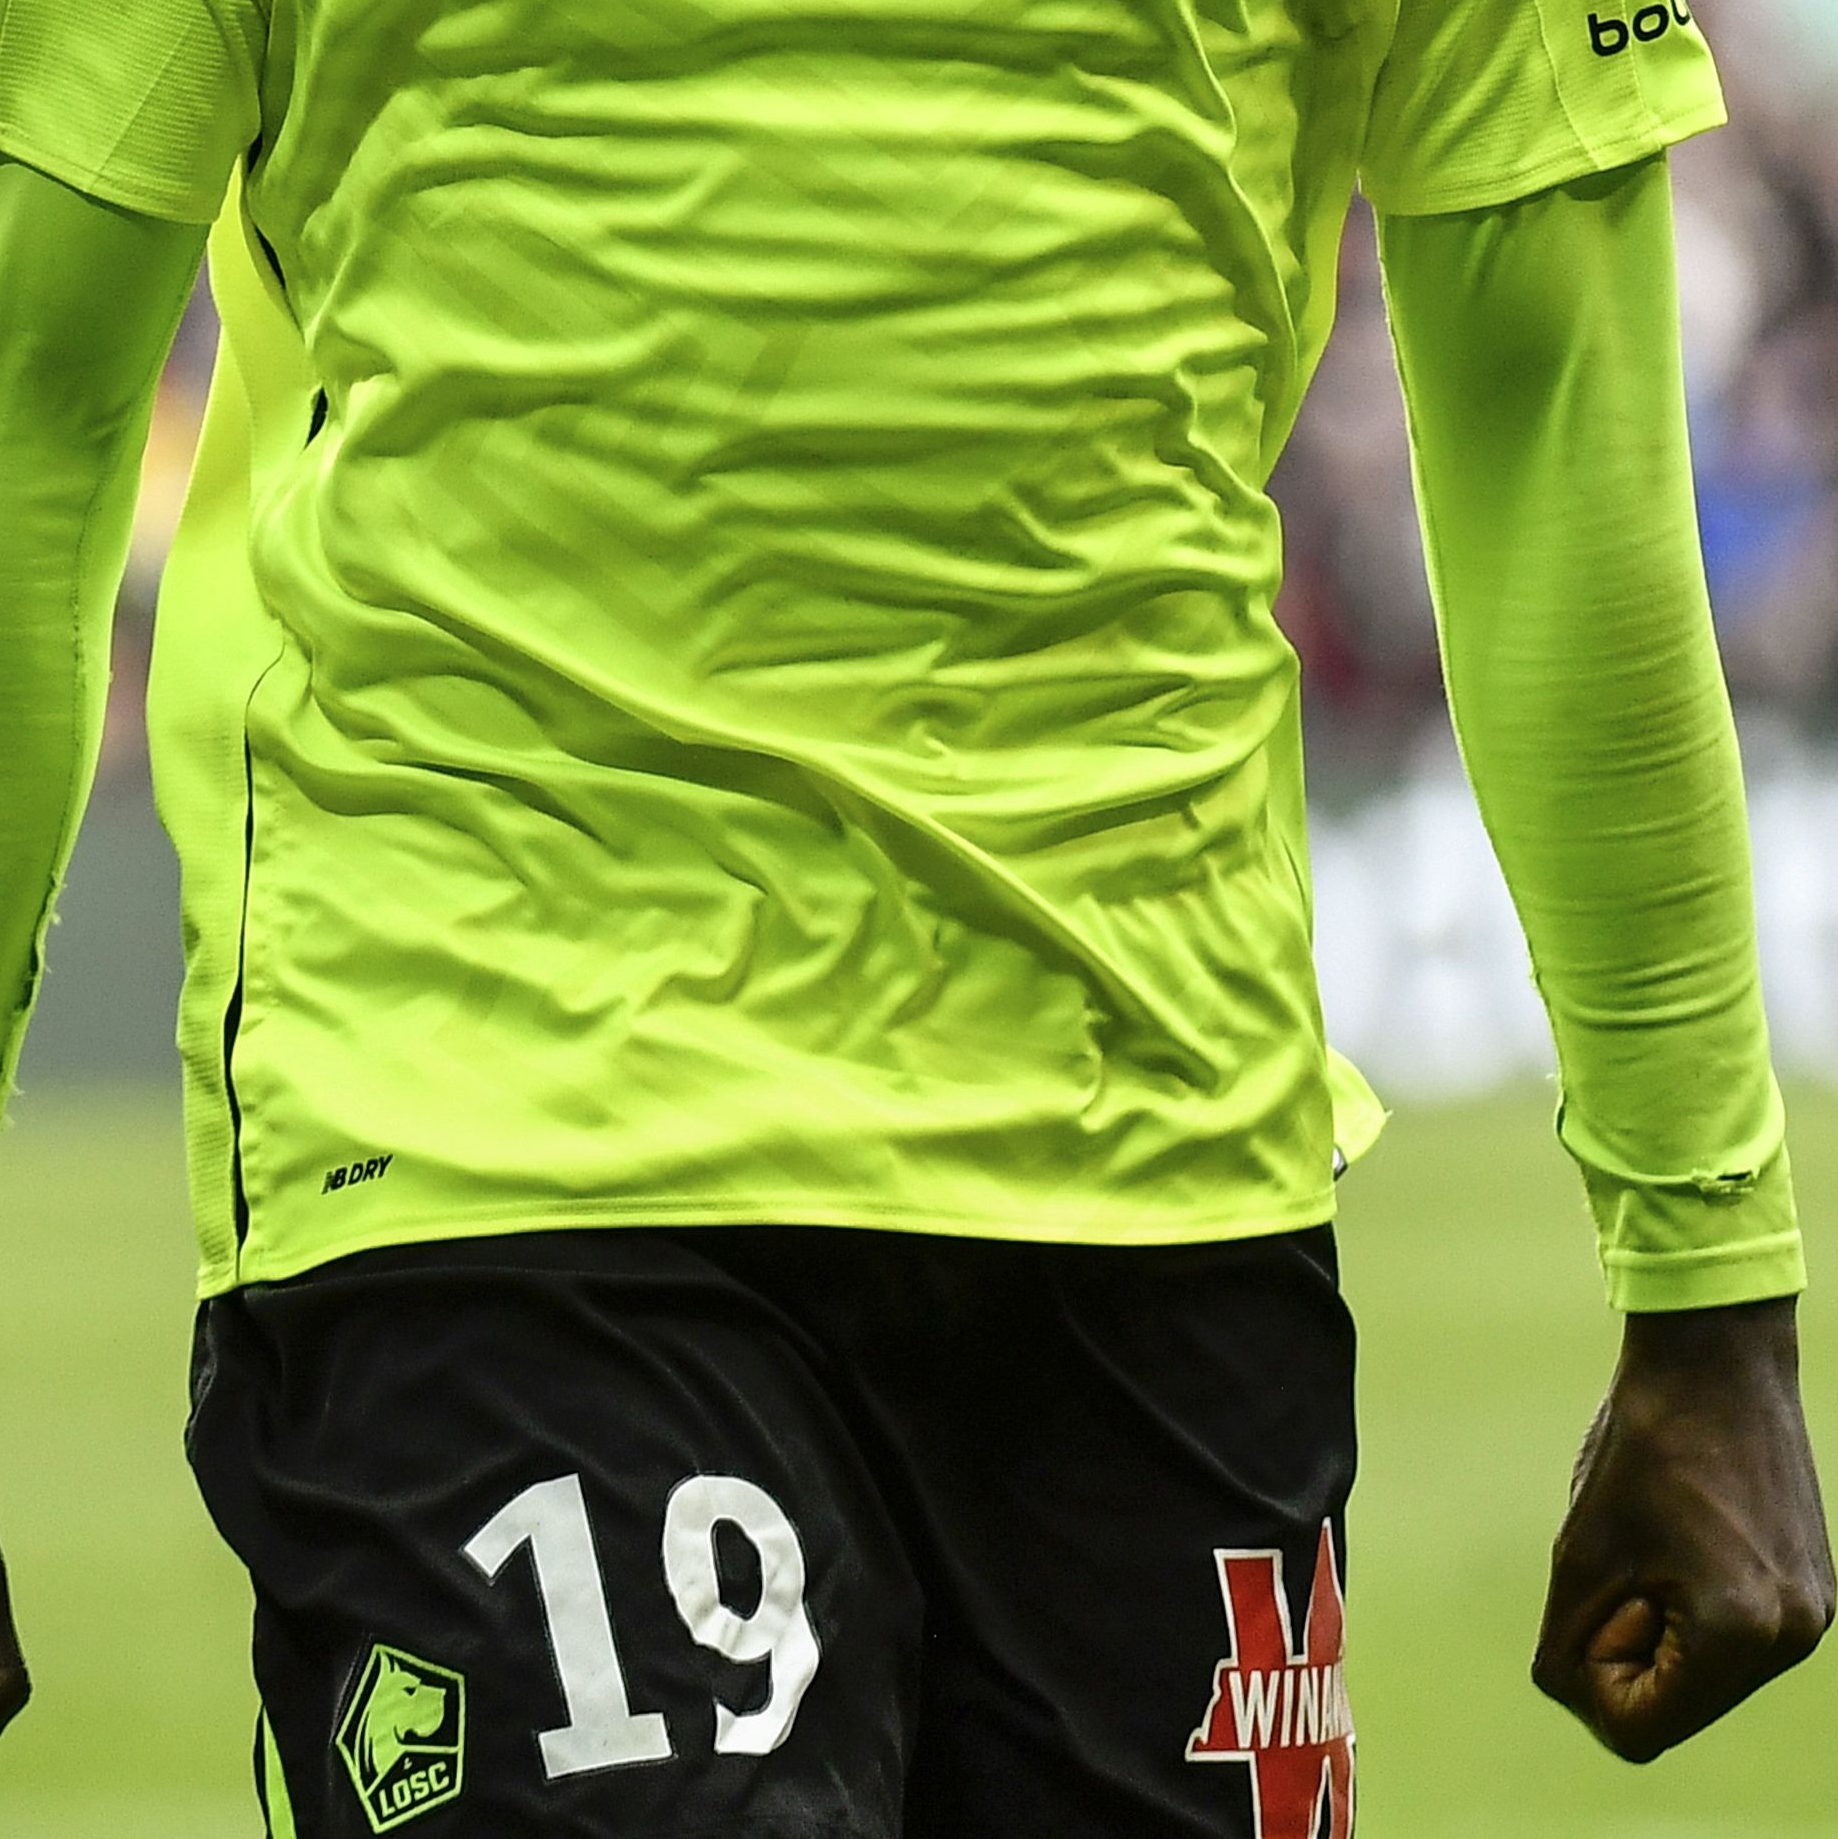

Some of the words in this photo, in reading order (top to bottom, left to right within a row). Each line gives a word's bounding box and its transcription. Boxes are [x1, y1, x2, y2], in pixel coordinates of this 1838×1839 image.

[348, 1154, 393, 1186] DRY
[463, 1473, 820, 1779] 19
[379, 1761, 450, 1818] LOSC
